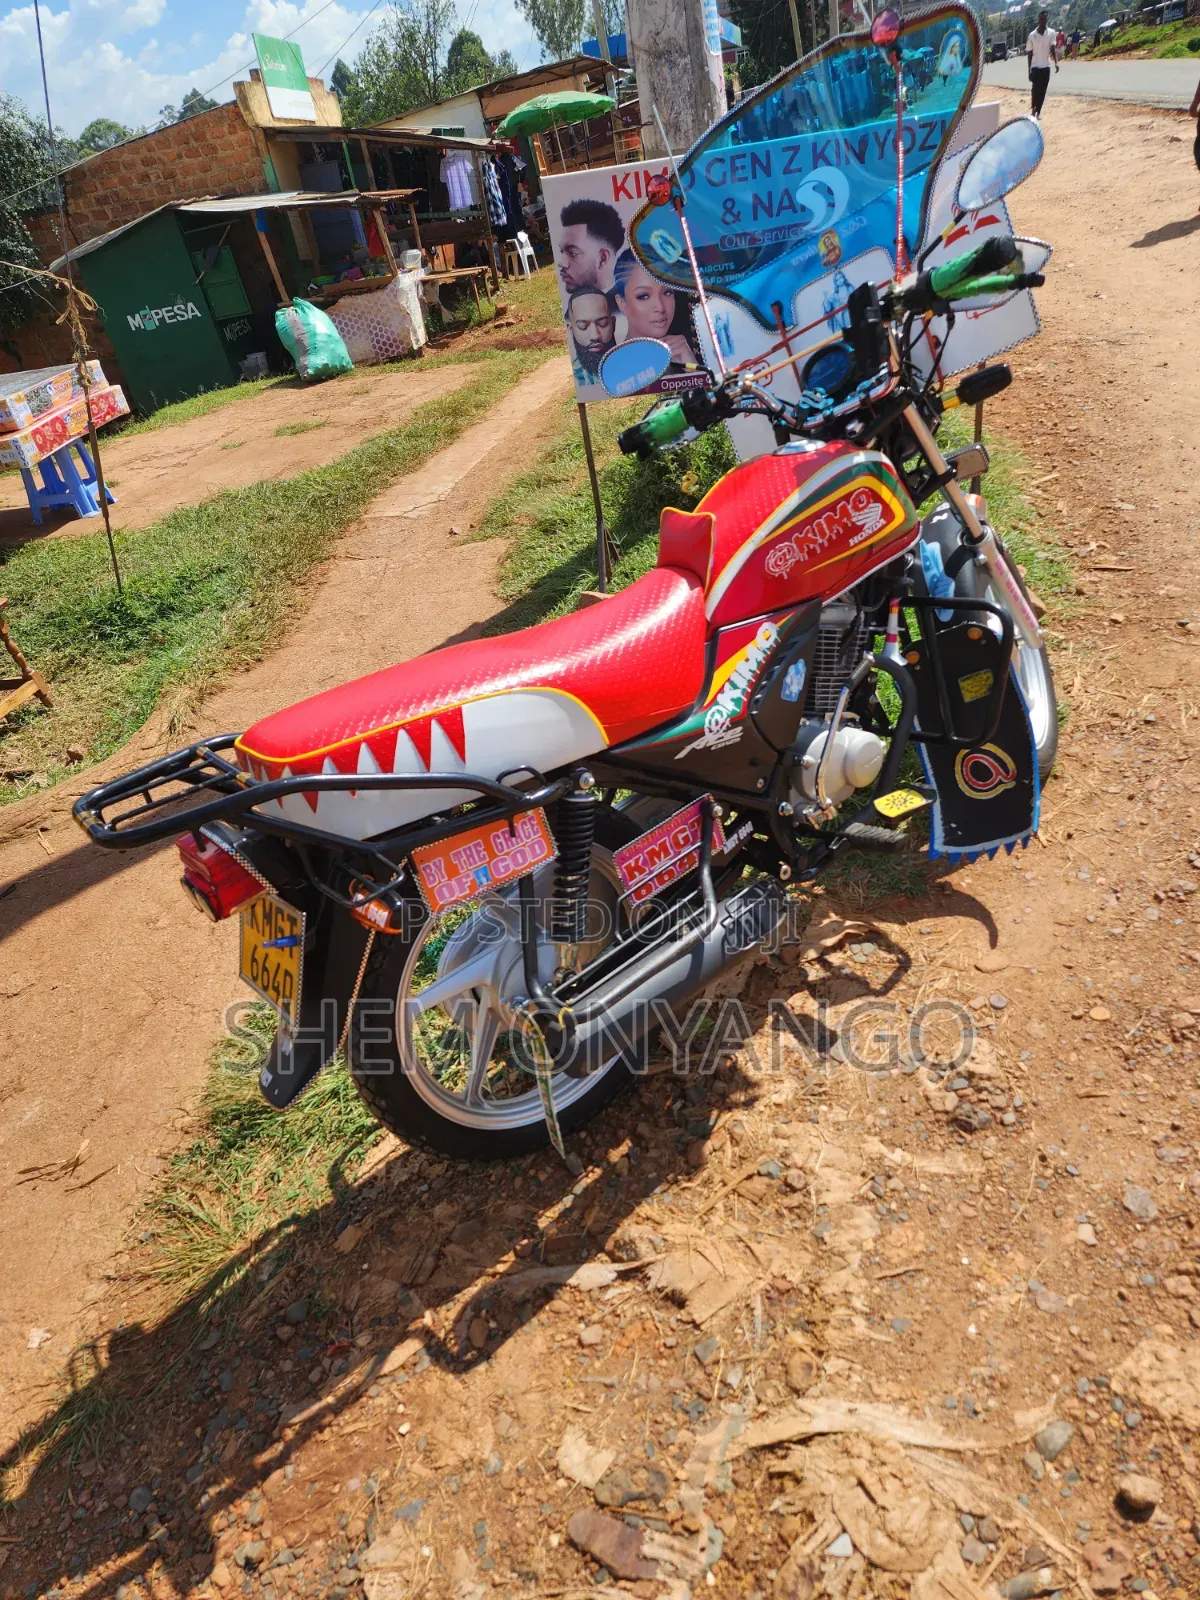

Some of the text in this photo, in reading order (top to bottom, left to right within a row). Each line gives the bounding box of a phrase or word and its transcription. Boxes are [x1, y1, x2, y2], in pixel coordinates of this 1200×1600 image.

[705, 149, 772, 187] GEN
[781, 144, 803, 175] Z
[811, 119, 947, 169] KINYOZI
[725, 225, 807, 248] Our Service
[693, 262, 735, 275] AIRCUTS
[660, 377, 704, 391] Opposite
[848, 517, 888, 547] HONDA
[420, 815, 542, 888] BY THE GRACE
[434, 837, 548, 904] OF GOD
[631, 832, 719, 904] 664
[250, 898, 298, 959] KMGT
